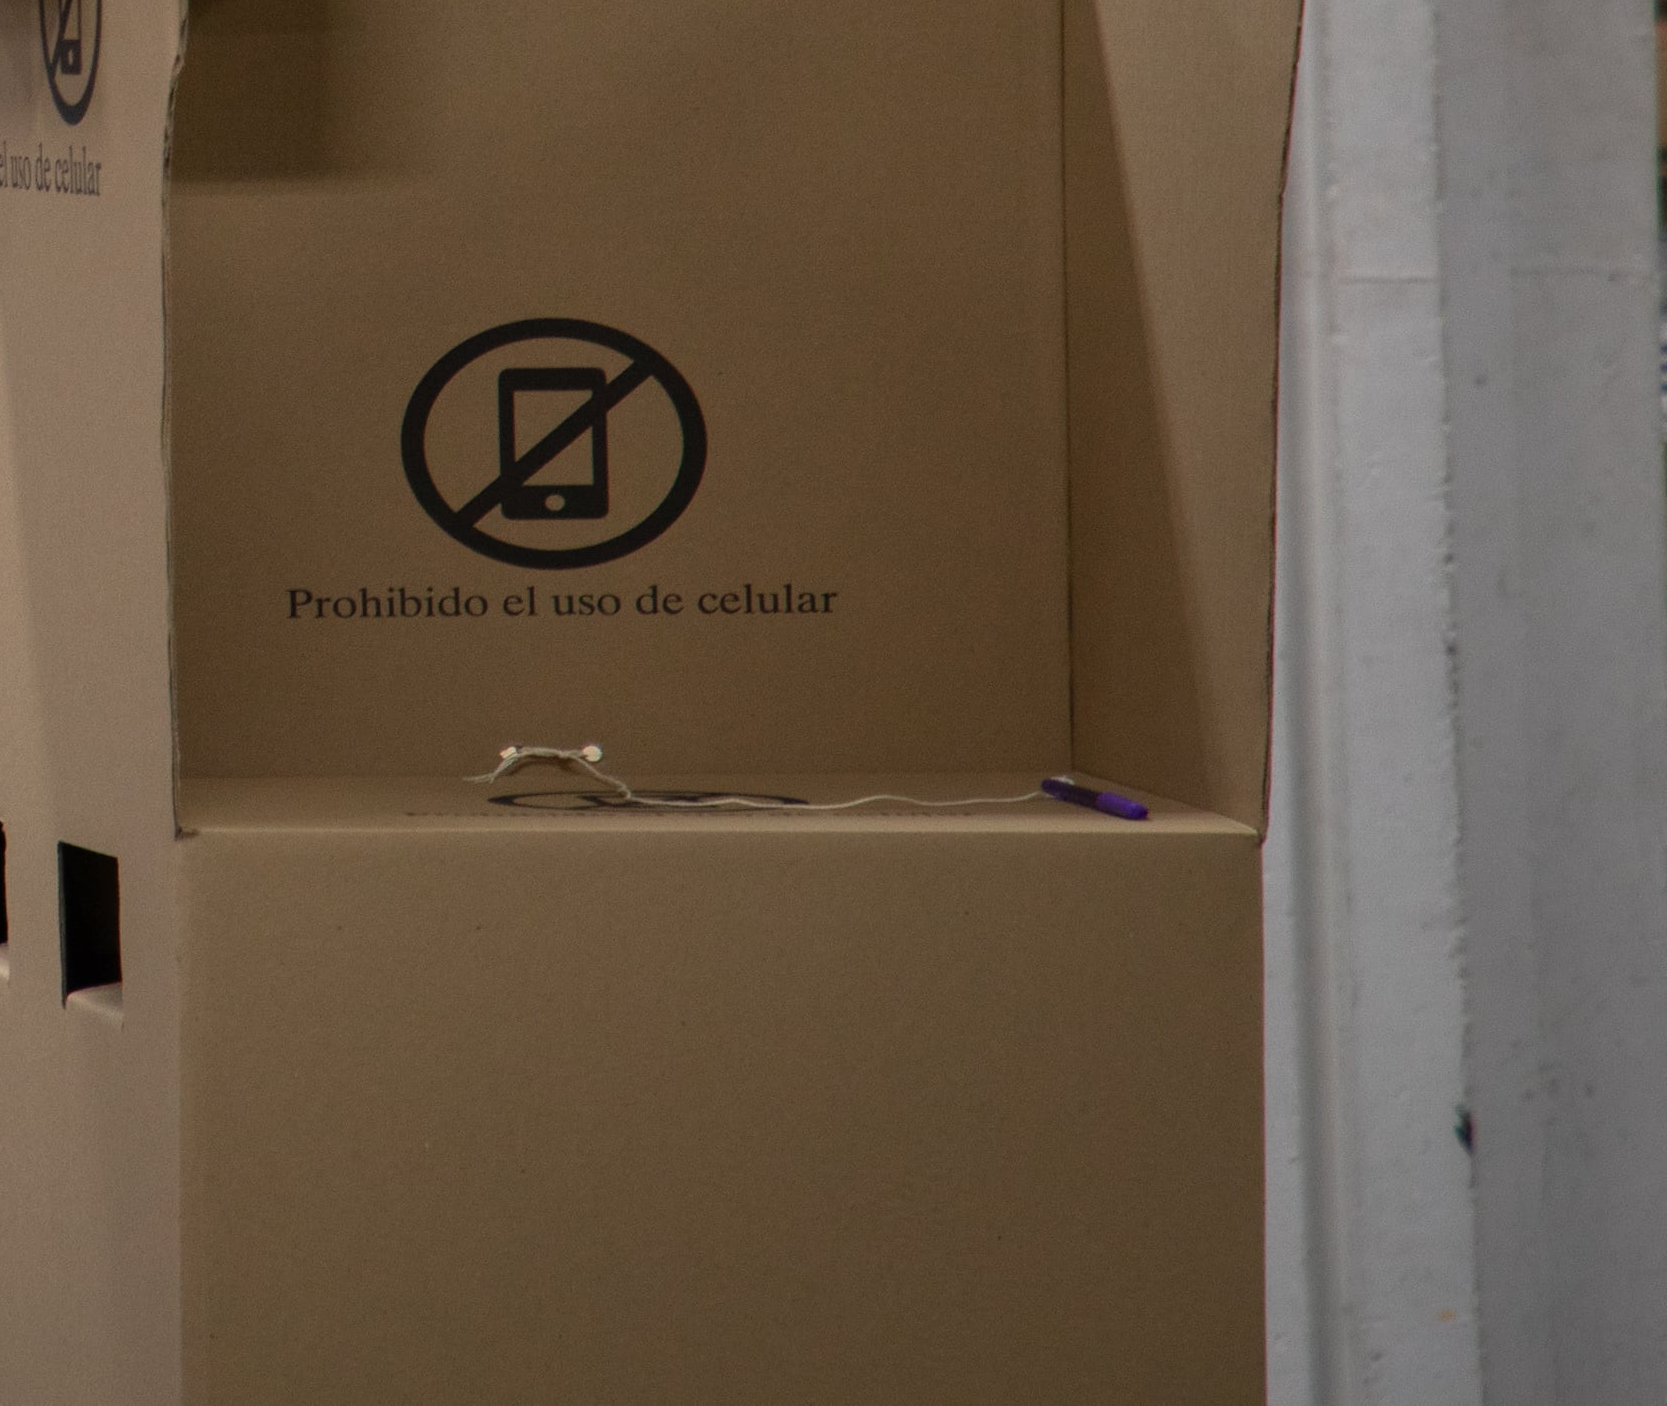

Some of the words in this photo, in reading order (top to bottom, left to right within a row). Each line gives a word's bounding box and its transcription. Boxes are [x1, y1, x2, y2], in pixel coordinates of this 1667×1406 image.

[11, 154, 32, 191] uso
[35, 144, 51, 192] de
[55, 147, 102, 196] celular
[286, 586, 489, 620] Prohibido
[502, 585, 537, 617] el
[552, 593, 622, 617] uso
[635, 584, 683, 616] de
[697, 582, 839, 615] celular
